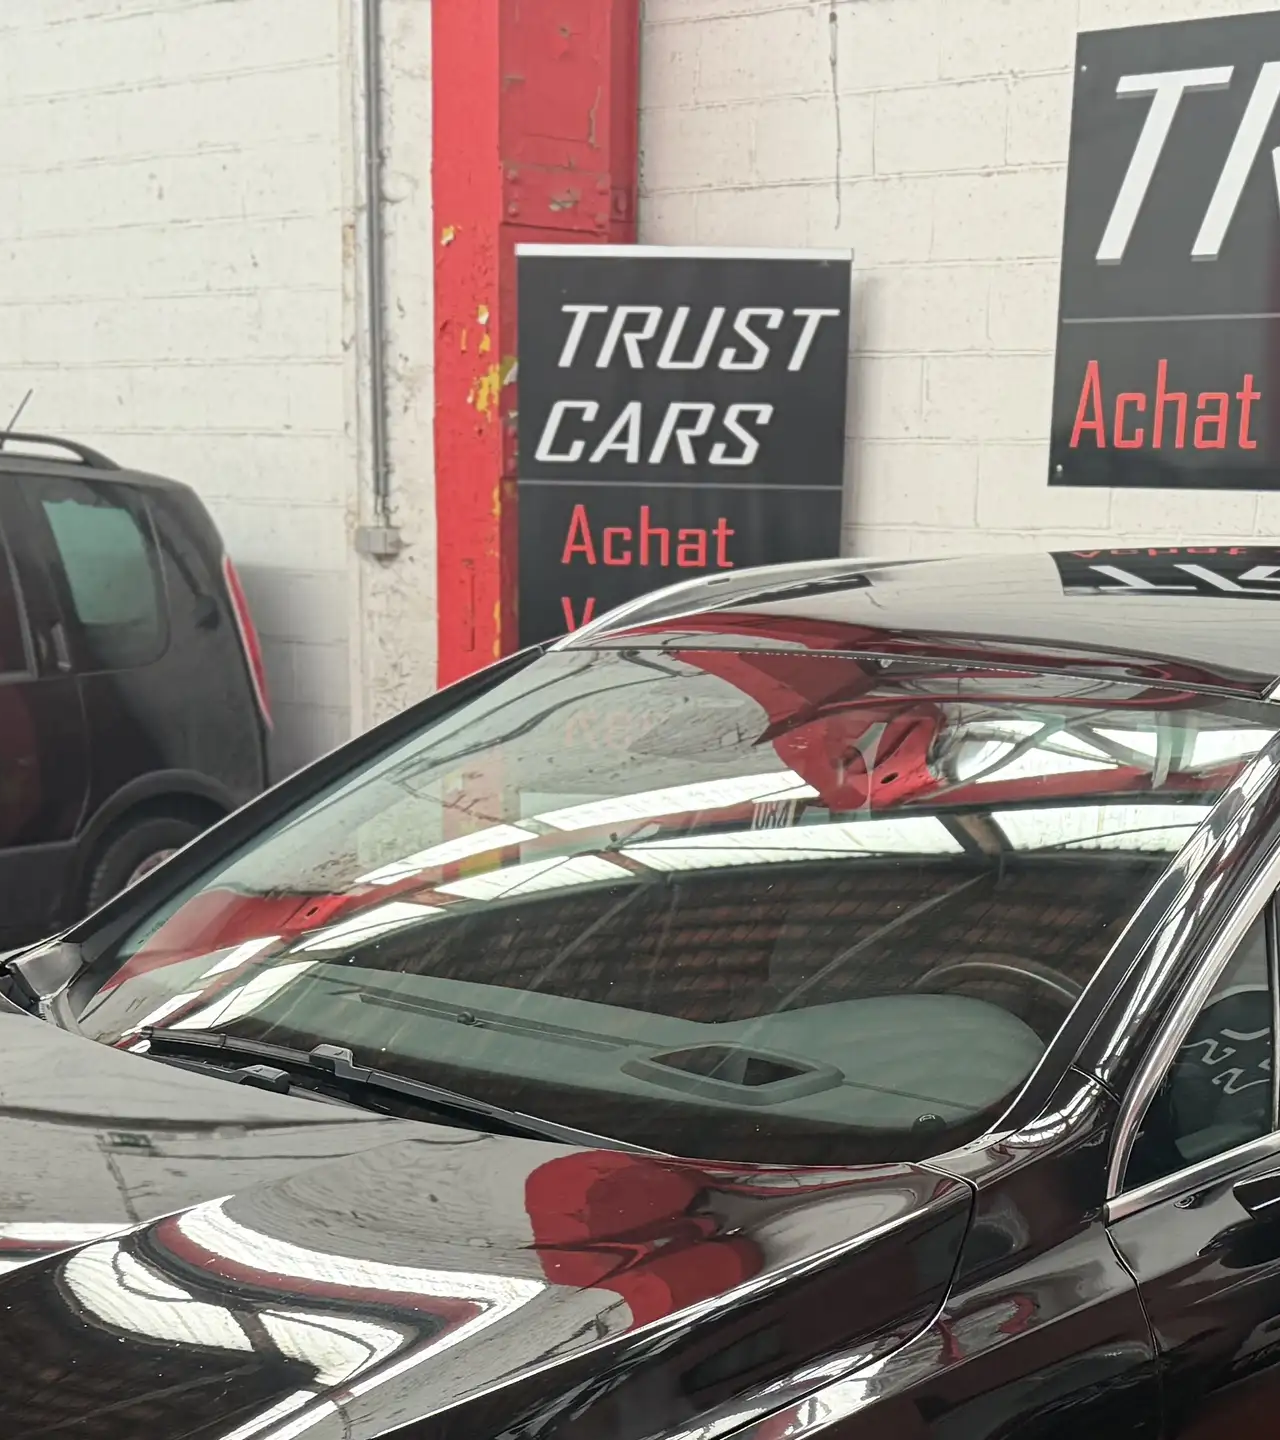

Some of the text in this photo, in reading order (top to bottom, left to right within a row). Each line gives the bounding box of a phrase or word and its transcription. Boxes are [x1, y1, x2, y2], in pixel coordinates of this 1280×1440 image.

[557, 305, 841, 372] TRUST
[533, 400, 774, 466] CARS
[1069, 358, 1262, 450] Achat
[560, 504, 735, 568] Achat
